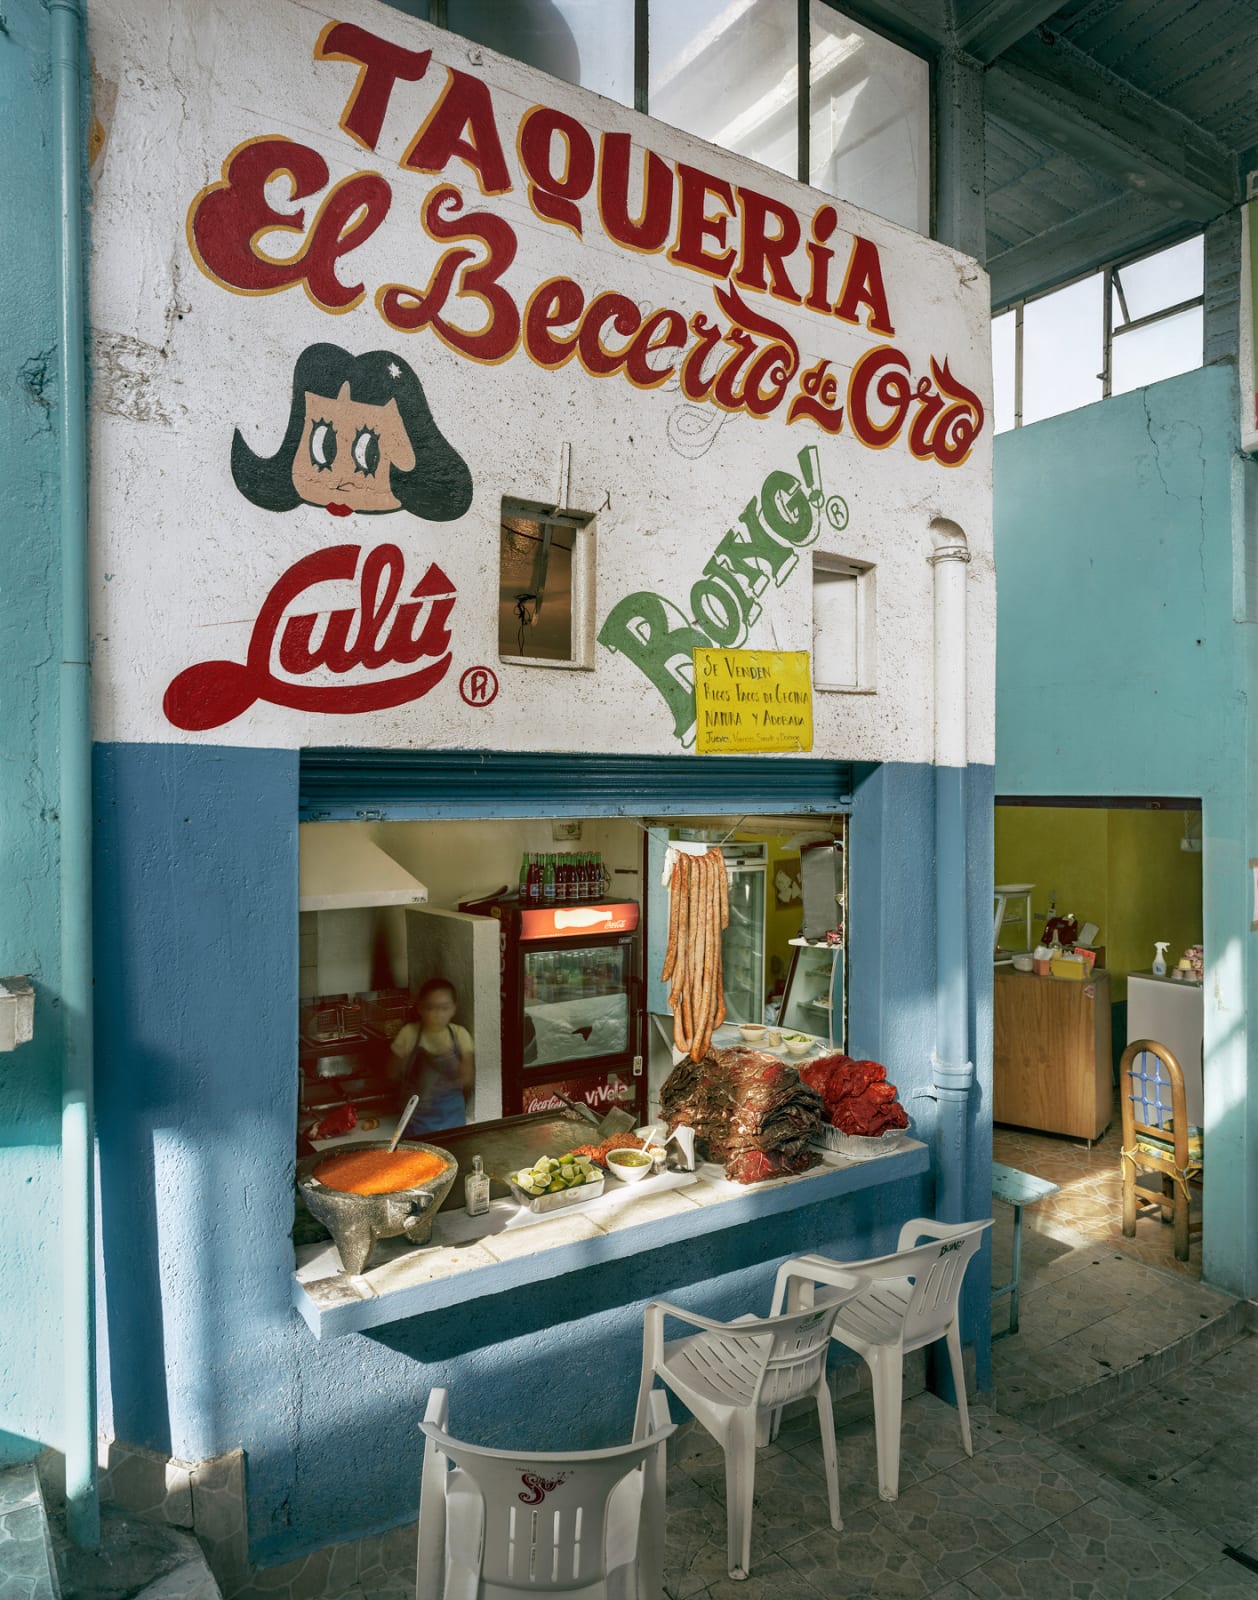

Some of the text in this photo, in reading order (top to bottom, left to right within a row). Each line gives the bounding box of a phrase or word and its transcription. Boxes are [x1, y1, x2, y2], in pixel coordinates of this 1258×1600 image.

[186, 134, 392, 315] El
[374, 183, 799, 419] Becerro
[847, 345, 984, 468] Oro
[163, 543, 457, 731] Lulú
